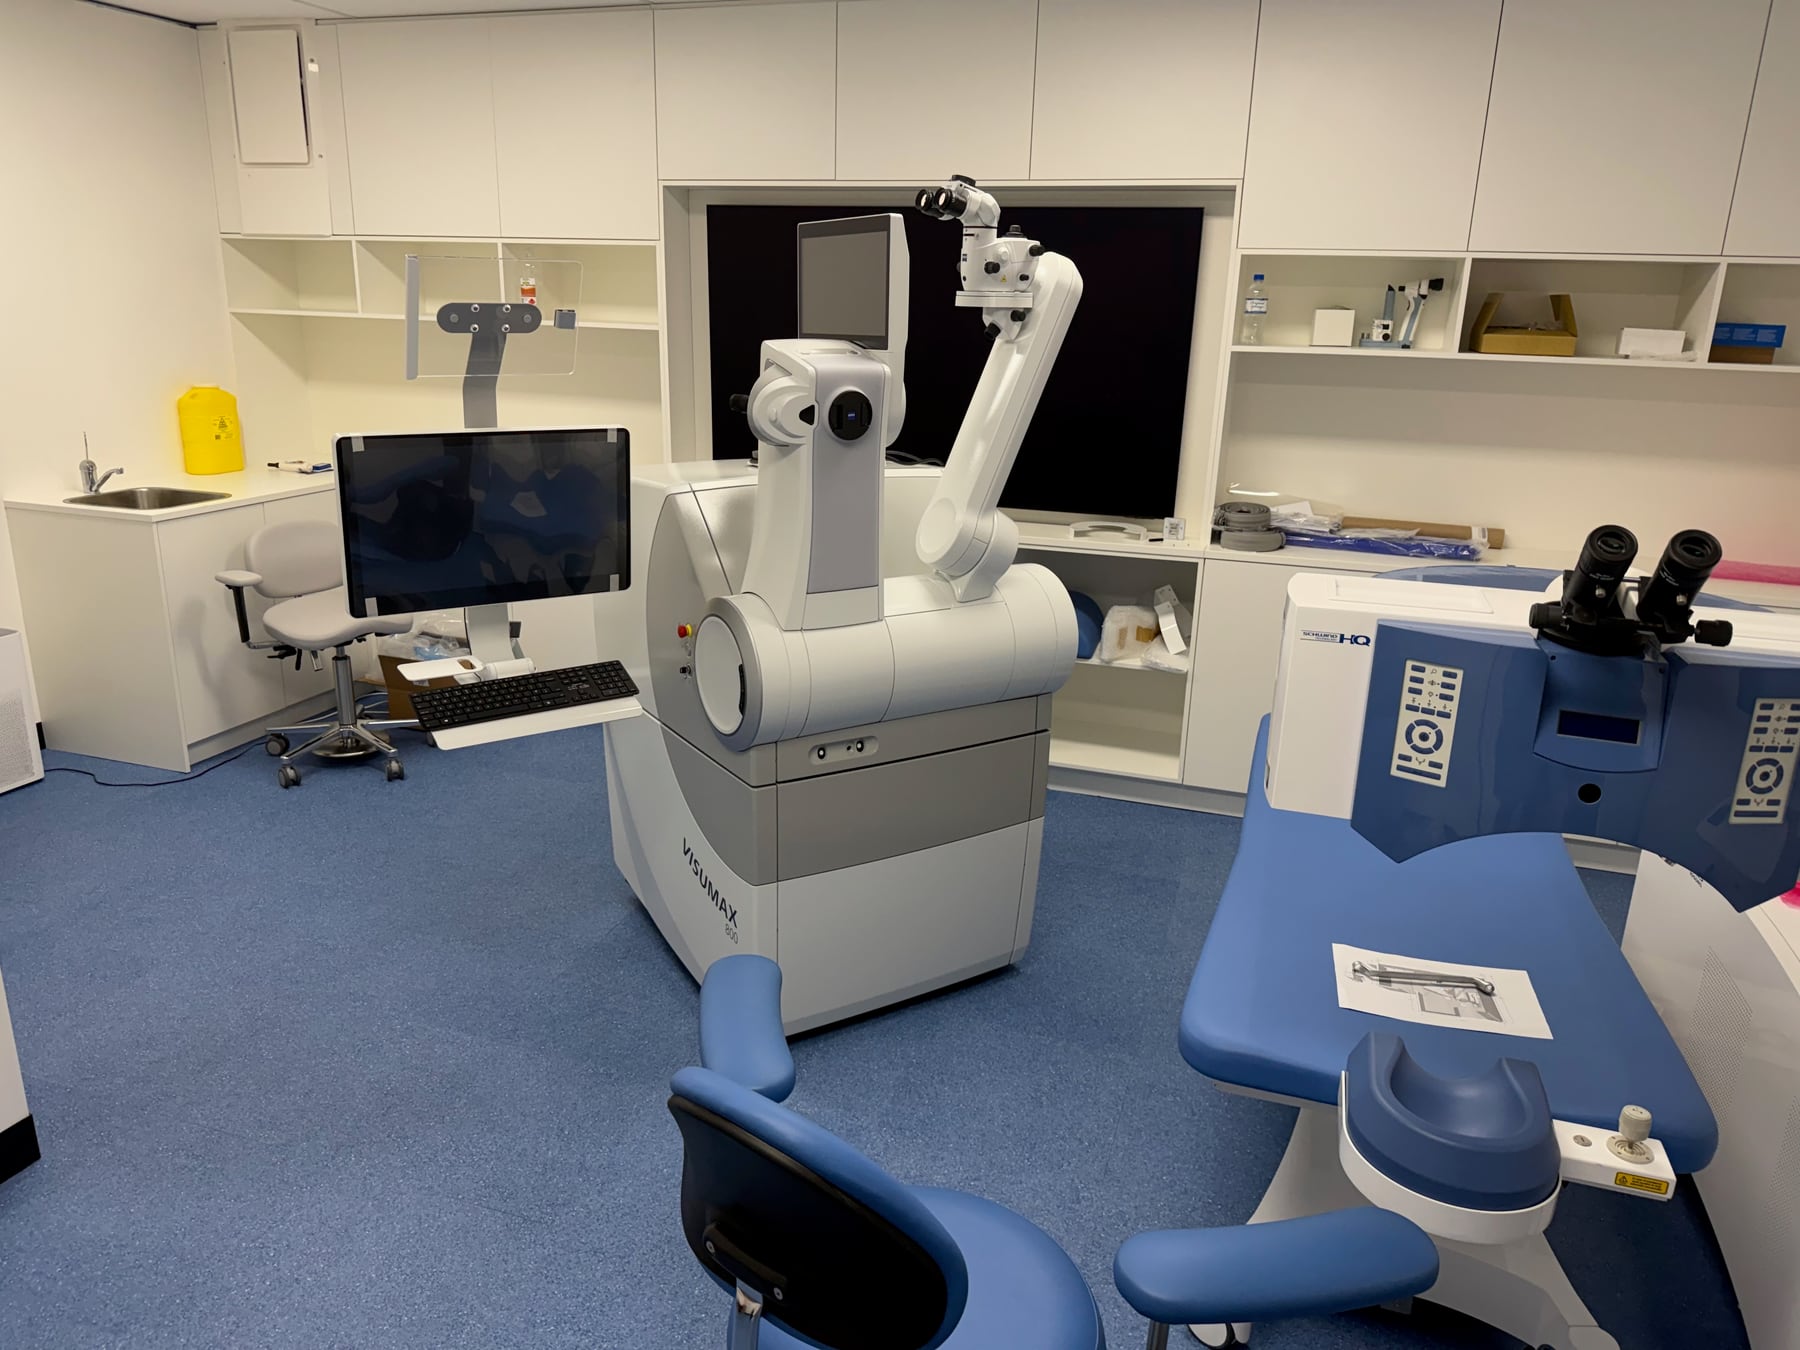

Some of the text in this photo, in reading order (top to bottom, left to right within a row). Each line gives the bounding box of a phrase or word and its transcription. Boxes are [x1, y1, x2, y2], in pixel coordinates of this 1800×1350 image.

[1339, 633, 1371, 647] HQ
[681, 836, 738, 929] VISUMAX
[724, 923, 739, 944] 800
